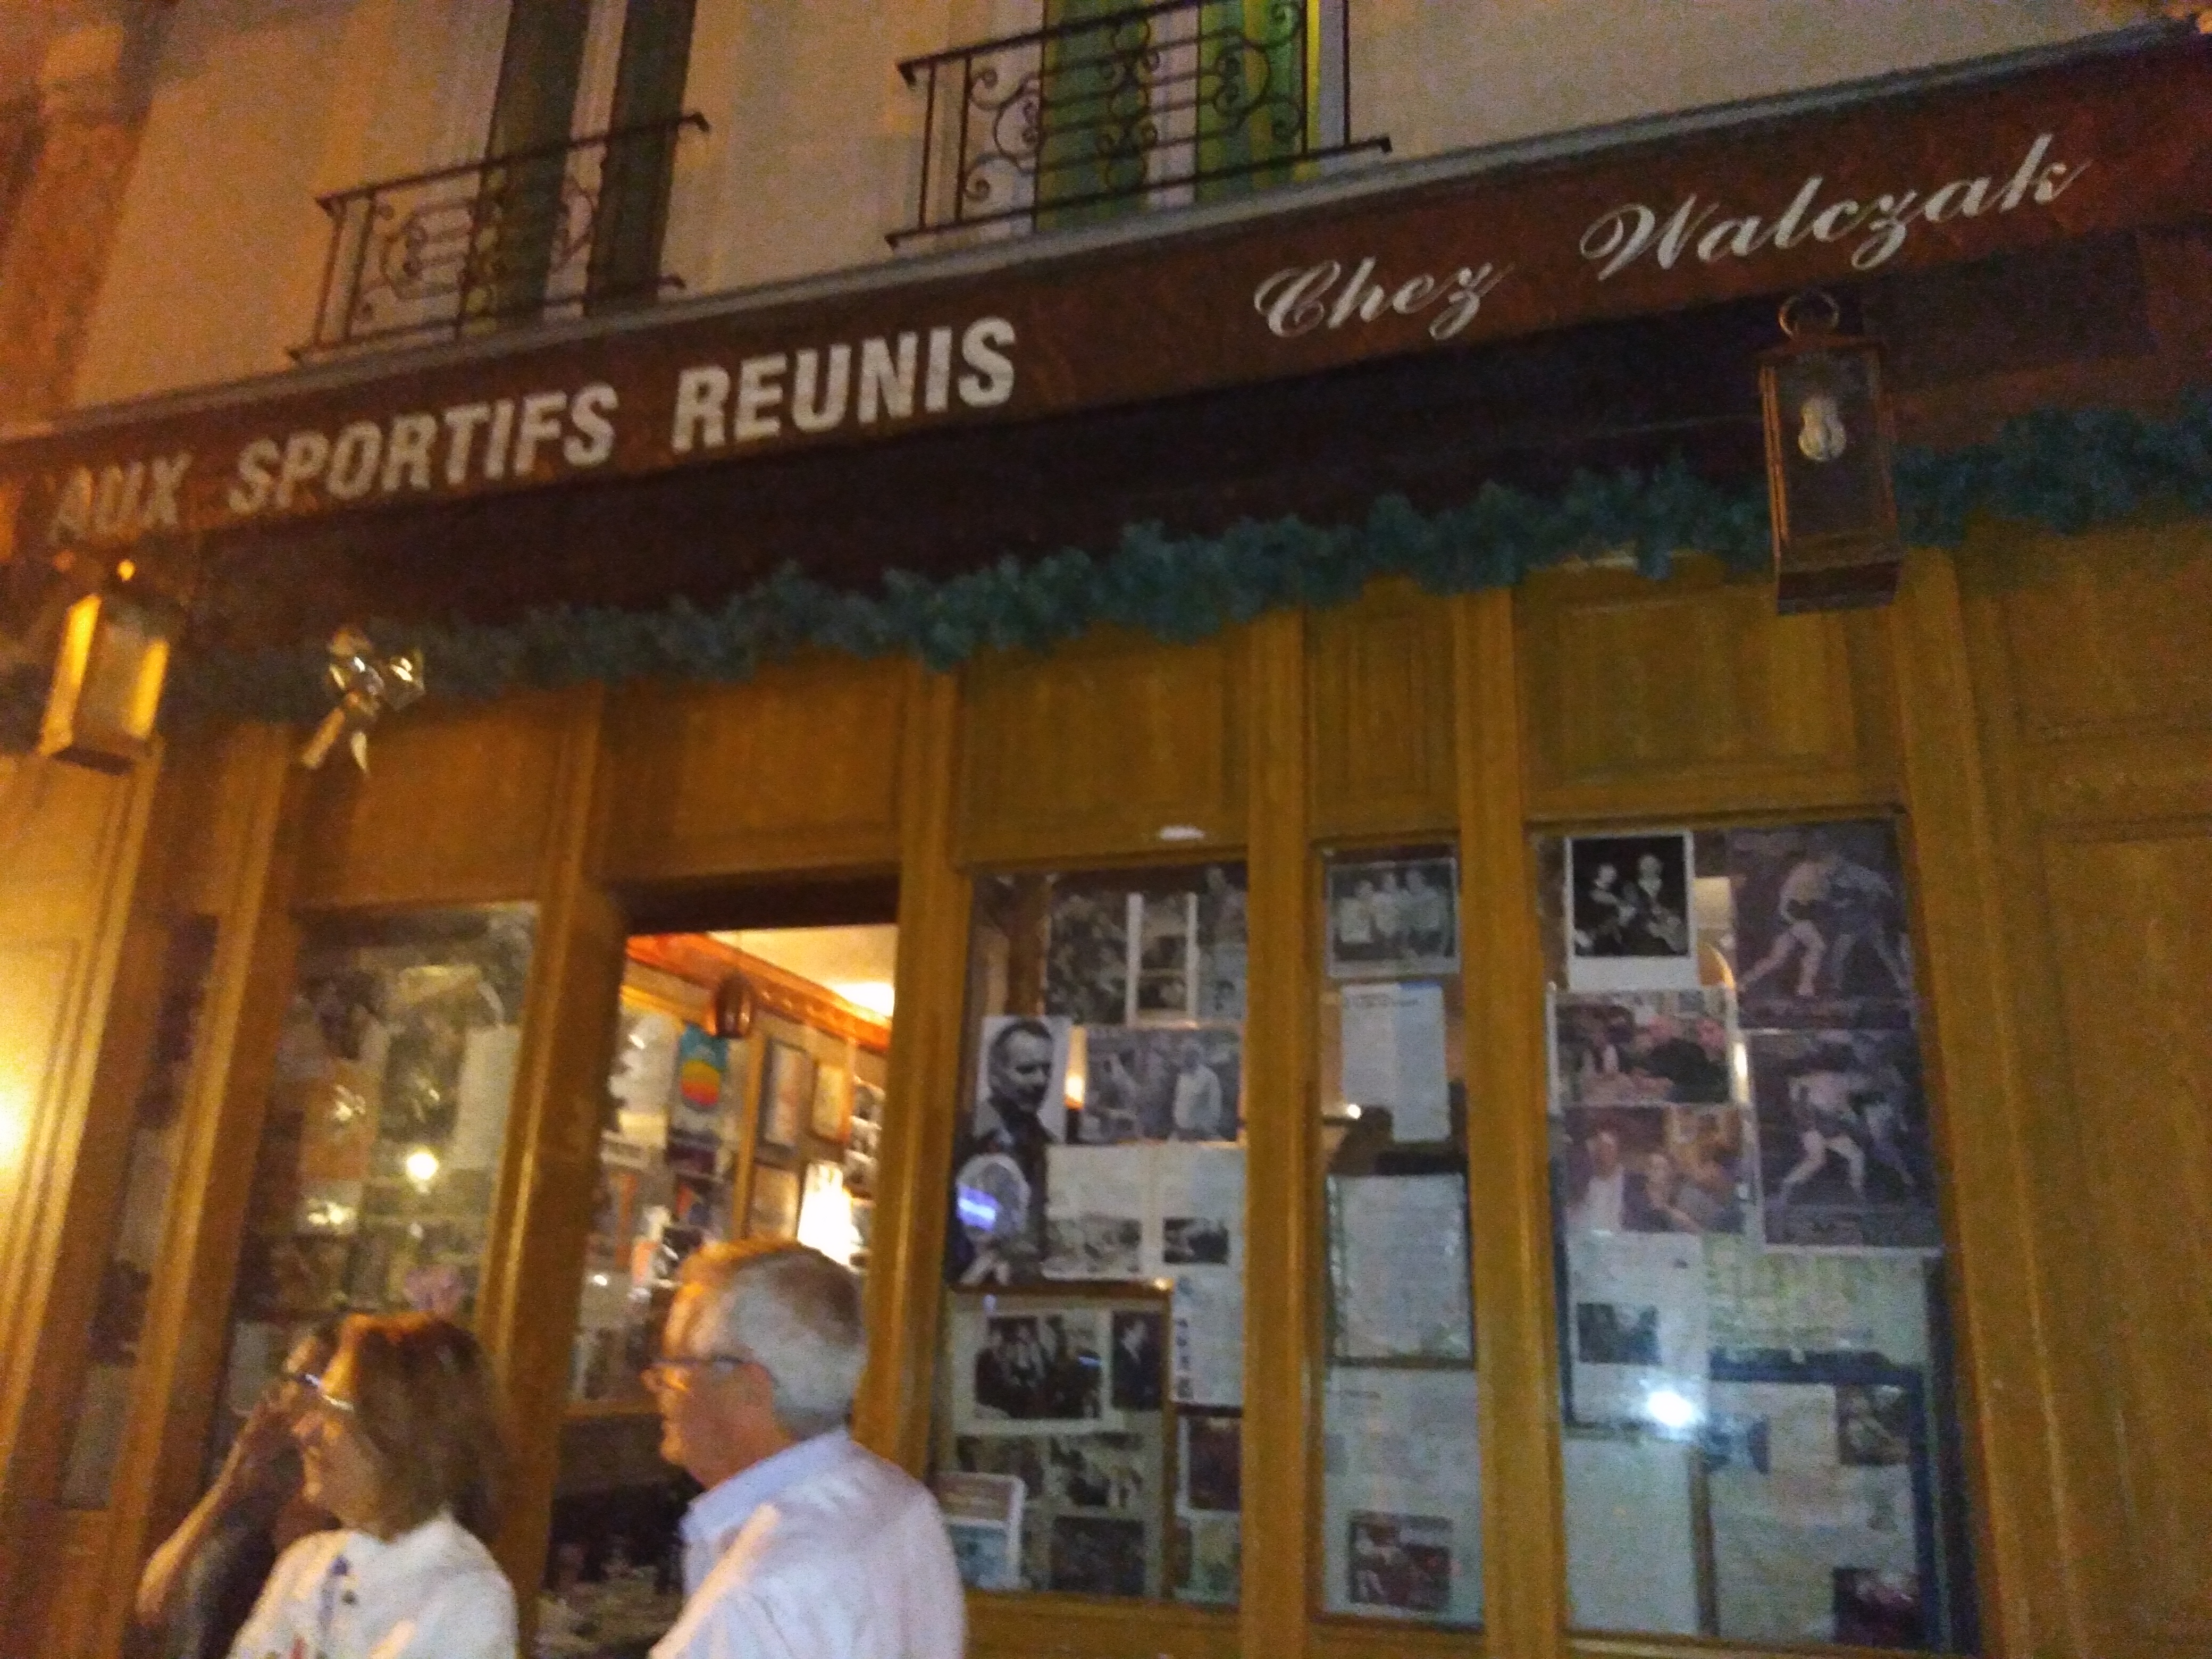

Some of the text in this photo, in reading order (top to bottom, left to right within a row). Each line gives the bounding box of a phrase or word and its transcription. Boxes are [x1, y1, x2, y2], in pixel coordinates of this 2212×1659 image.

[1254, 133, 2092, 341] Chez Walczak
[52, 316, 1018, 541] AUX SPORTIFS REUNIS
